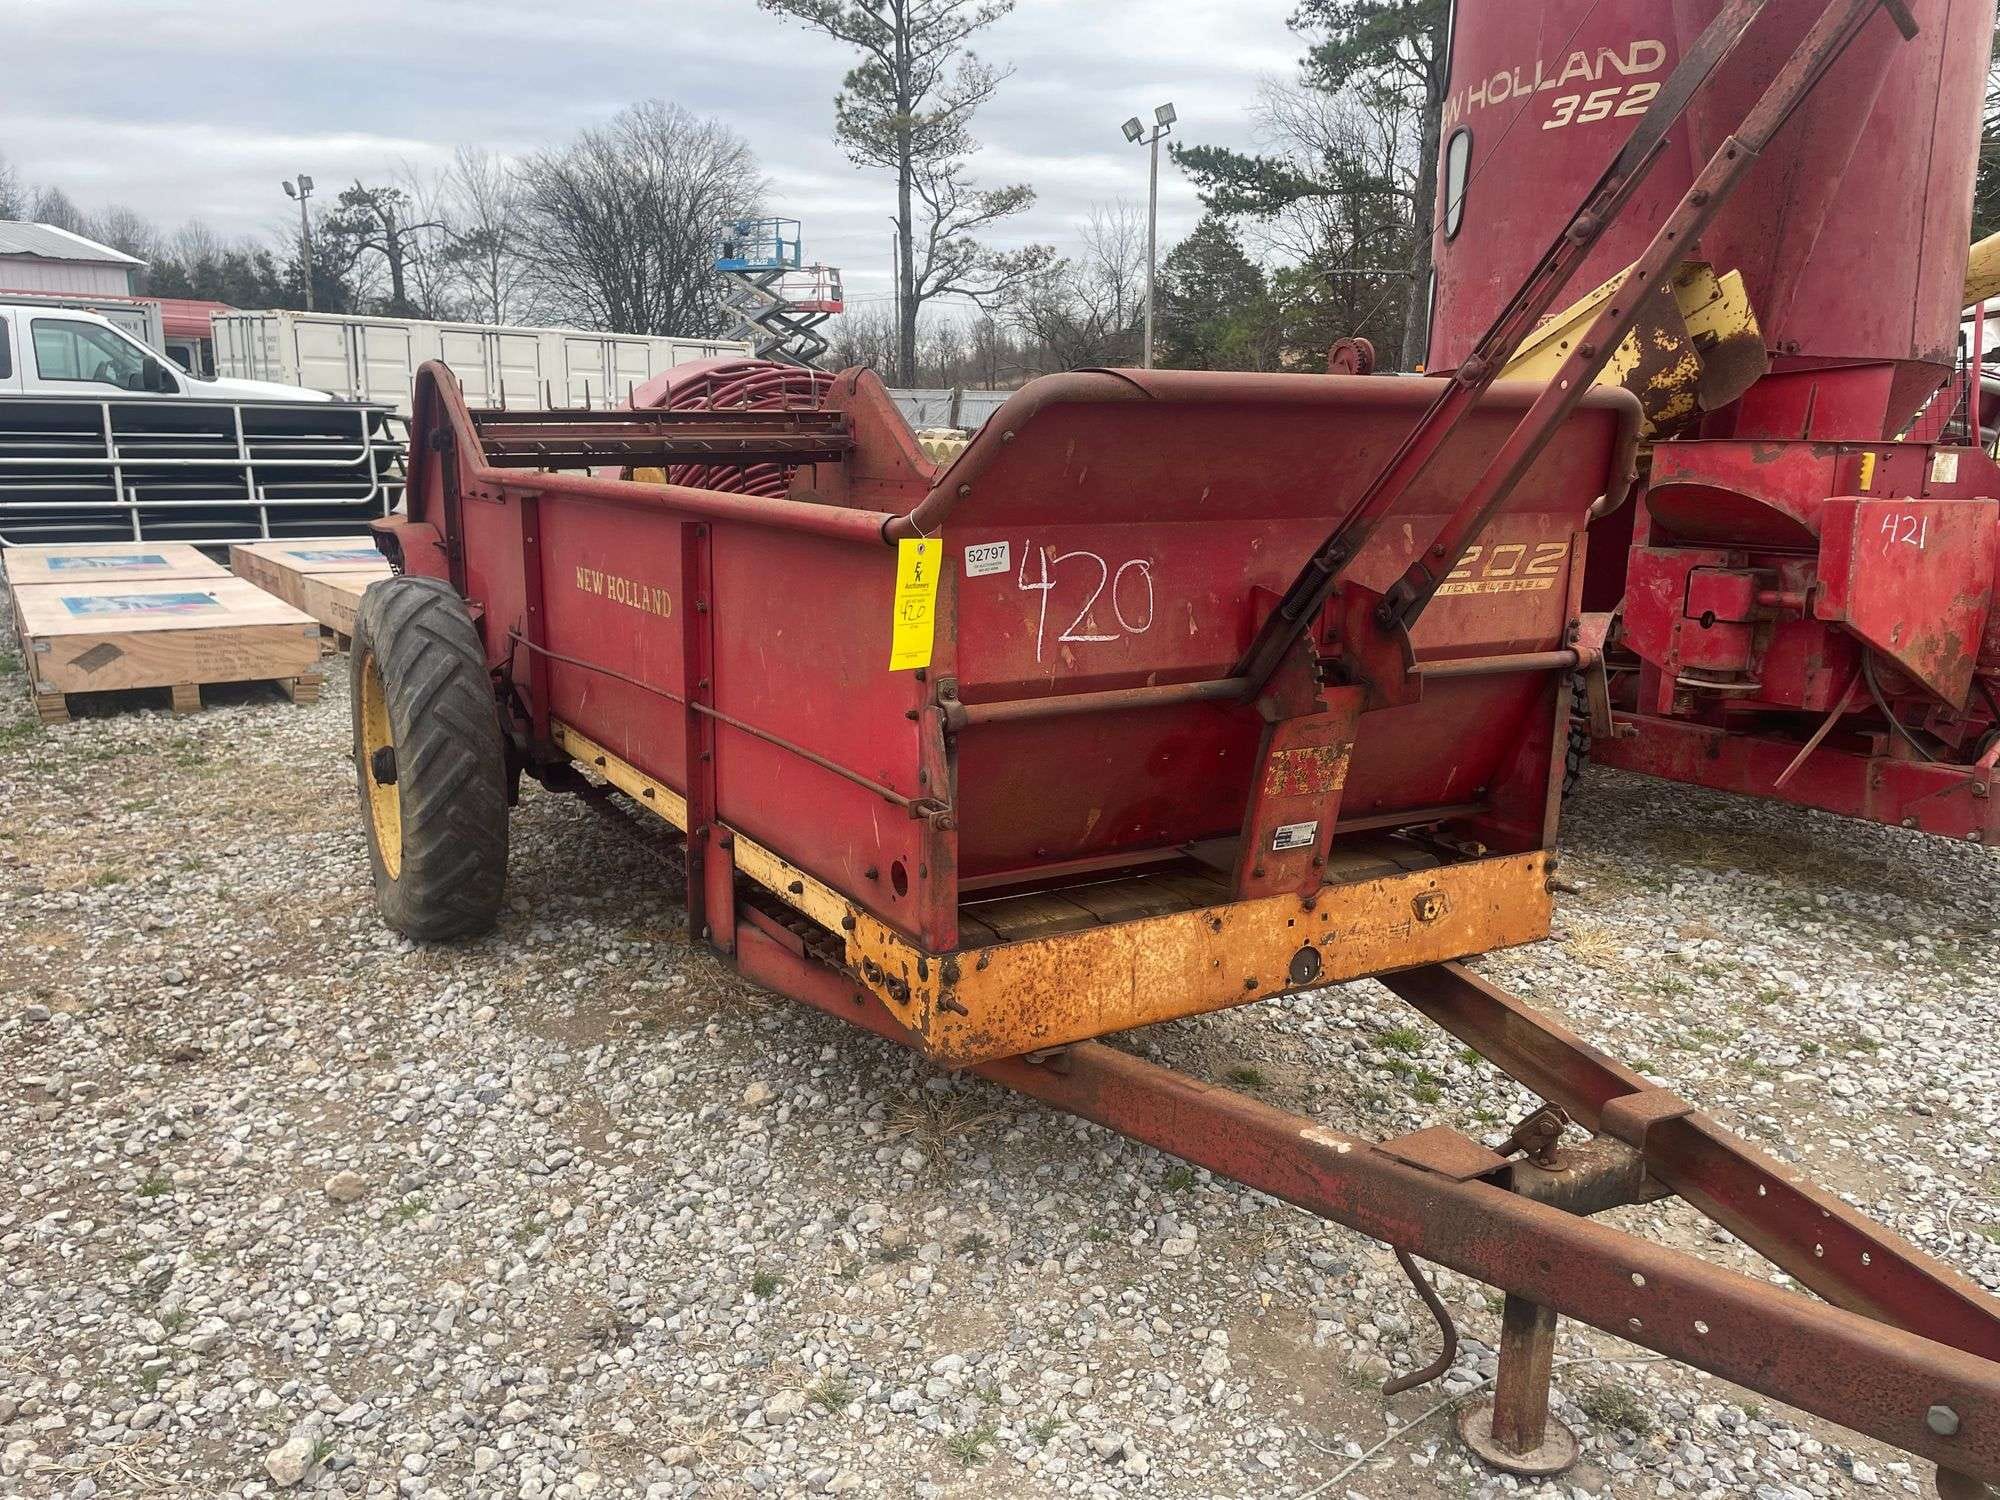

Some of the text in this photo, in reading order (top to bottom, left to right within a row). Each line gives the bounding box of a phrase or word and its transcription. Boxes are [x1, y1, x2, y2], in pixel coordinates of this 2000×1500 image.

[1467, 39, 1667, 114] HOLLAND
[1542, 82, 1661, 130] 352
[968, 545, 1006, 563] 52797
[1880, 513, 1928, 549] 421
[1447, 541, 1569, 579] 202
[576, 566, 671, 617] NEW HOLLAND
[1018, 539, 1153, 663] 420
